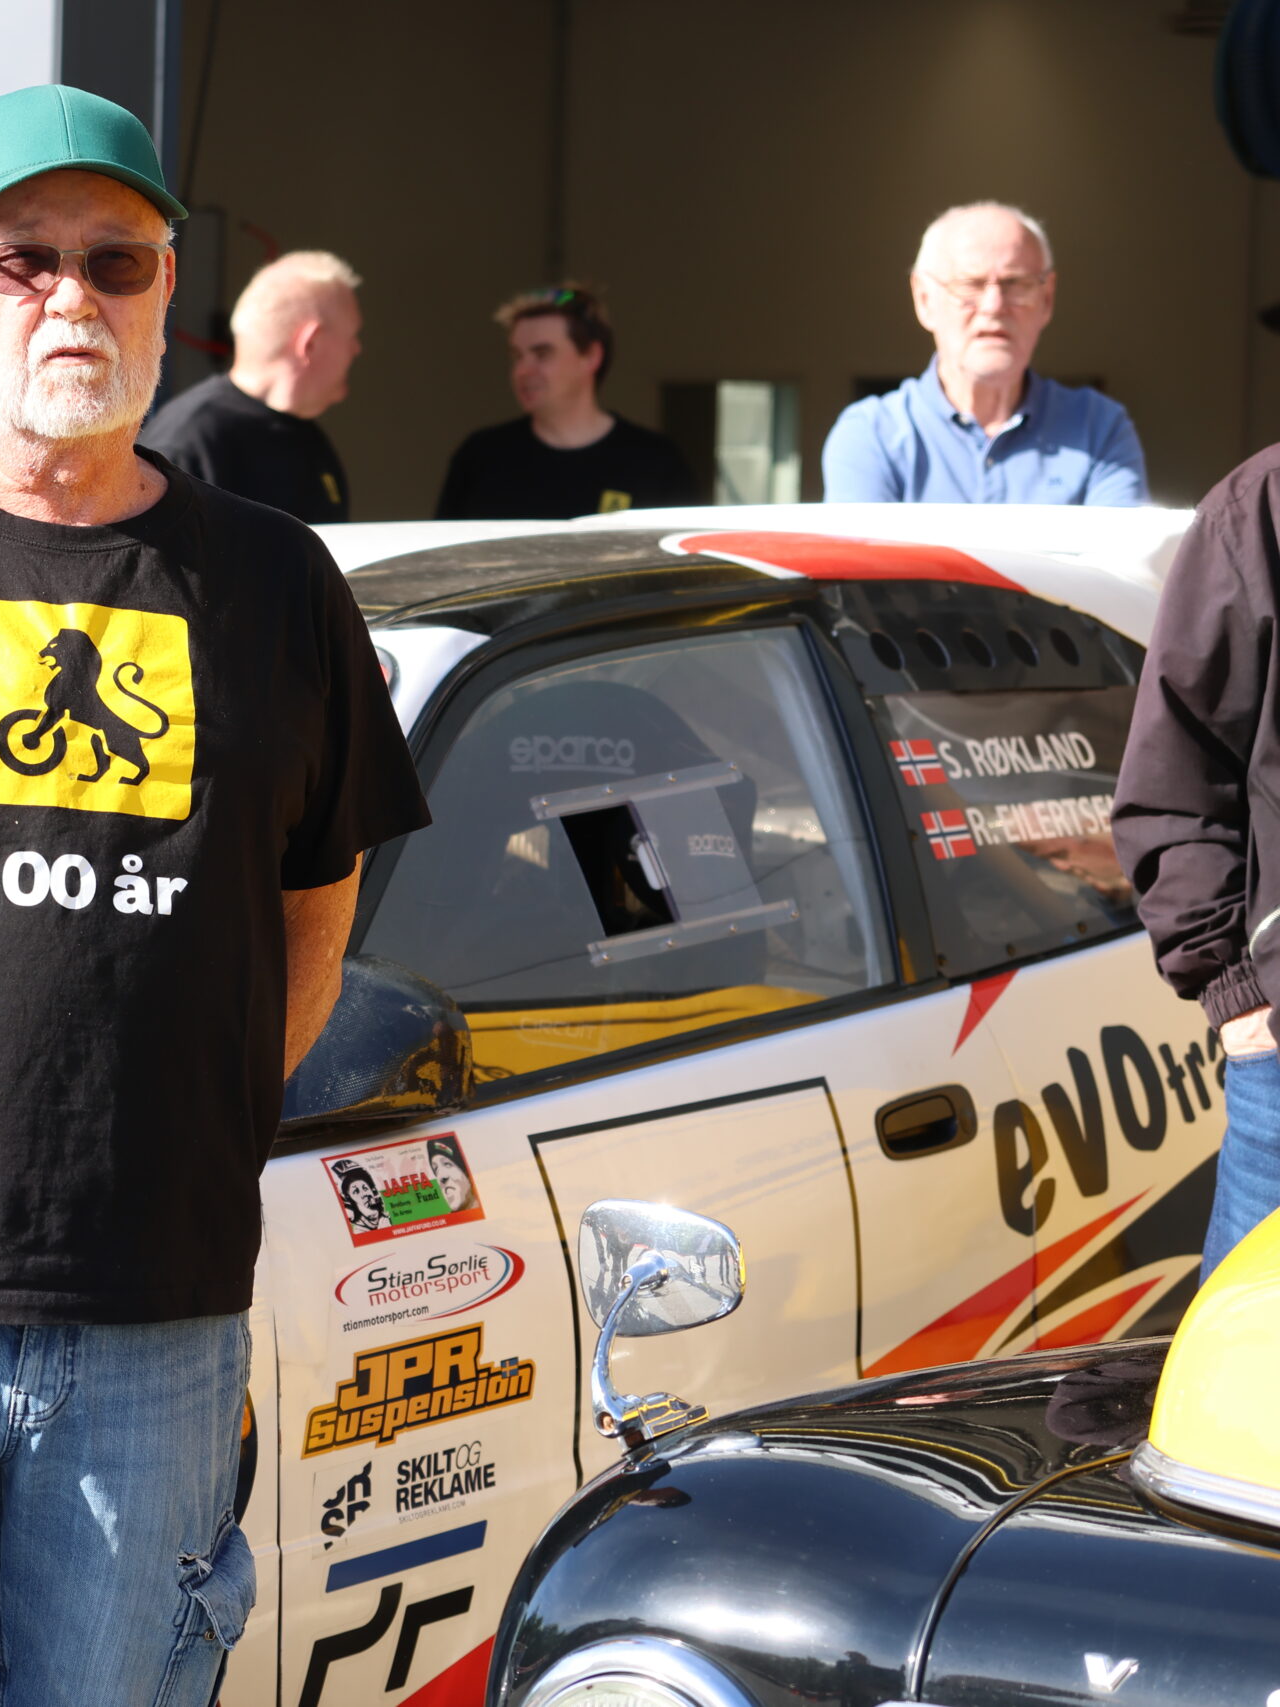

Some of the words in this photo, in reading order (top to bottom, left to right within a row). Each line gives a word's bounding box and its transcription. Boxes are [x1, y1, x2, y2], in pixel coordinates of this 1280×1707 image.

[509, 735, 636, 774] sparco
[938, 741, 972, 779] S.
[966, 732, 1096, 777] RØKLAND
[965, 808, 1000, 846] R.
[112, 853, 189, 916] år
[383, 1172, 433, 1197] JAFFA
[416, 1190, 440, 1204] Fund
[368, 1267, 425, 1292] Stian
[427, 1254, 488, 1279] Sørlie
[369, 1266, 491, 1306] motorsport
[343, 1304, 429, 1332] stianmotorsport.com
[339, 1329, 481, 1412] JPR
[307, 1366, 533, 1450] Suspension
[397, 1448, 456, 1486] SKILT
[456, 1440, 482, 1470] OG
[396, 1463, 496, 1513] REKLAME
